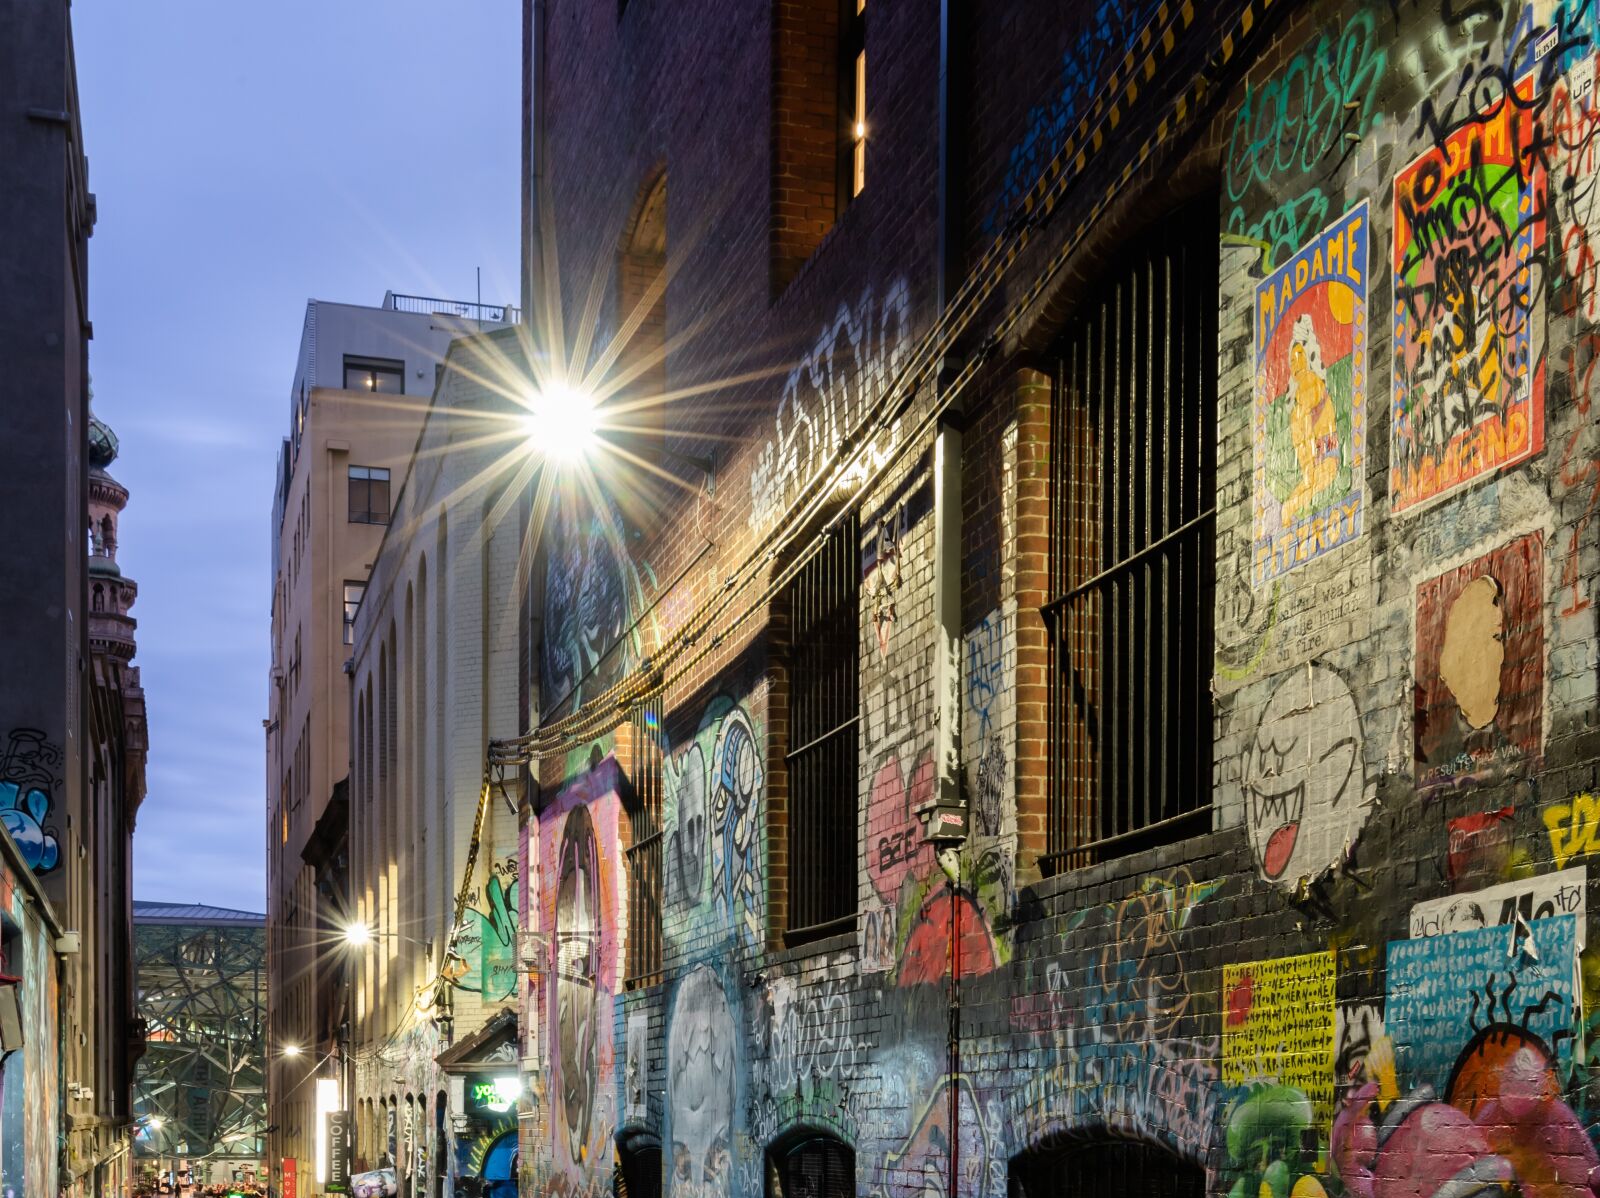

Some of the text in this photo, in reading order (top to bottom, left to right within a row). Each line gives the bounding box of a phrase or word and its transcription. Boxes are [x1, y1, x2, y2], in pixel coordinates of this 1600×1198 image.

[1573, 78, 1592, 100] UP
[1259, 216, 1362, 351] MADAME
[1257, 499, 1360, 582] FITZROY
[330, 1112, 343, 1183] COFFEE
